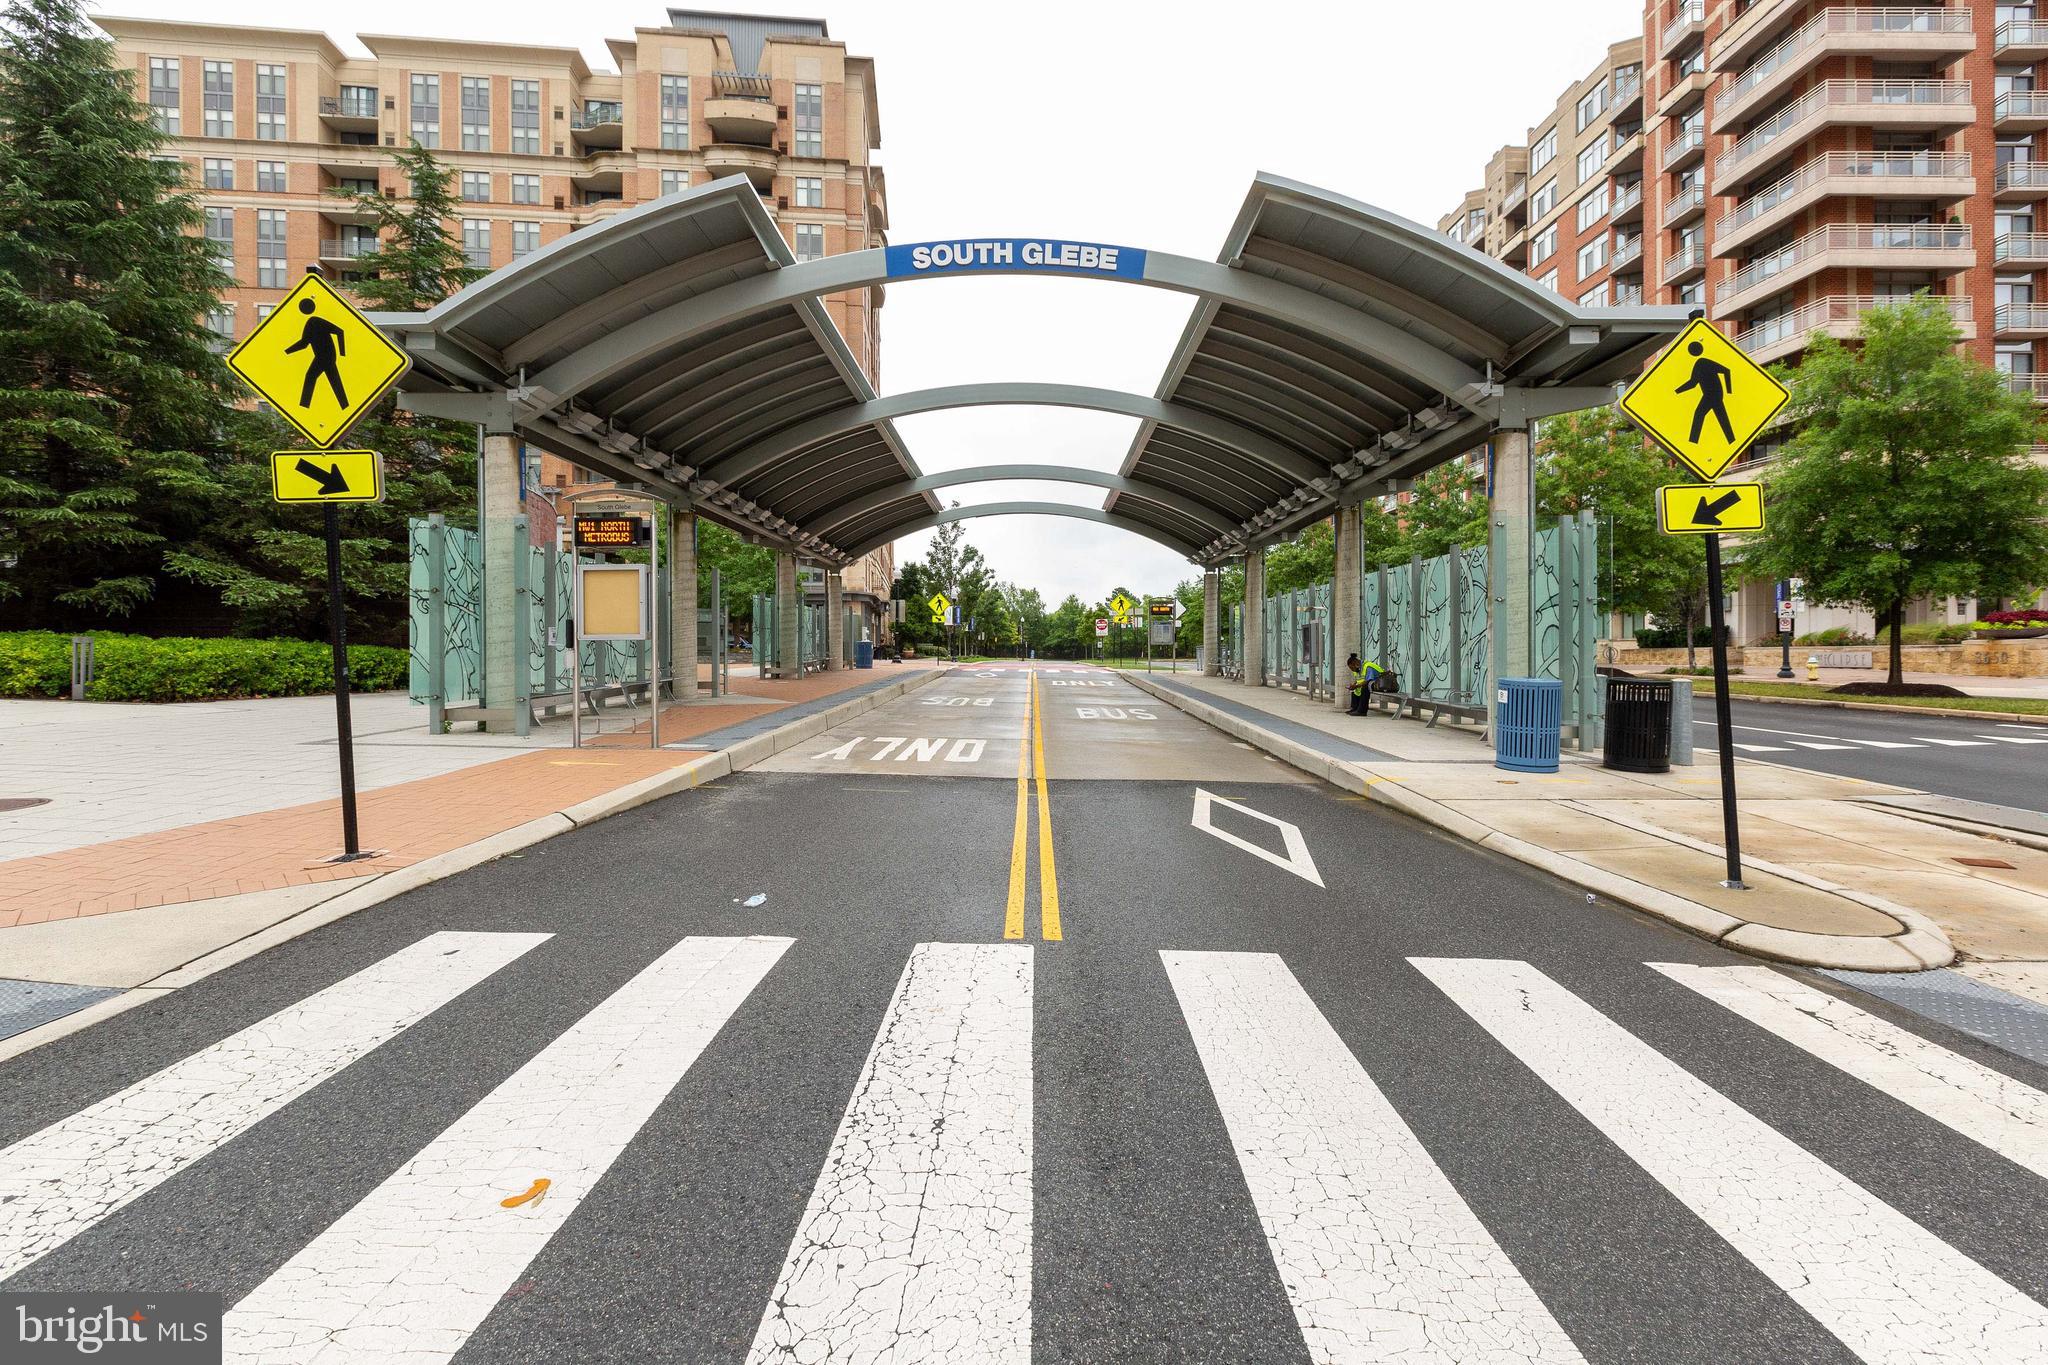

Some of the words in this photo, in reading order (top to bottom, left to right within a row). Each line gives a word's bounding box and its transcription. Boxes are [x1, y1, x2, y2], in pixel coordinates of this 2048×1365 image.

[912, 243, 1012, 269] SOUTH
[1022, 243, 1118, 270] GLEBE
[600, 521, 630, 531] NORTH
[921, 696, 995, 707] BUS
[1077, 707, 1158, 720] BUS
[810, 736, 988, 763] ONLY
